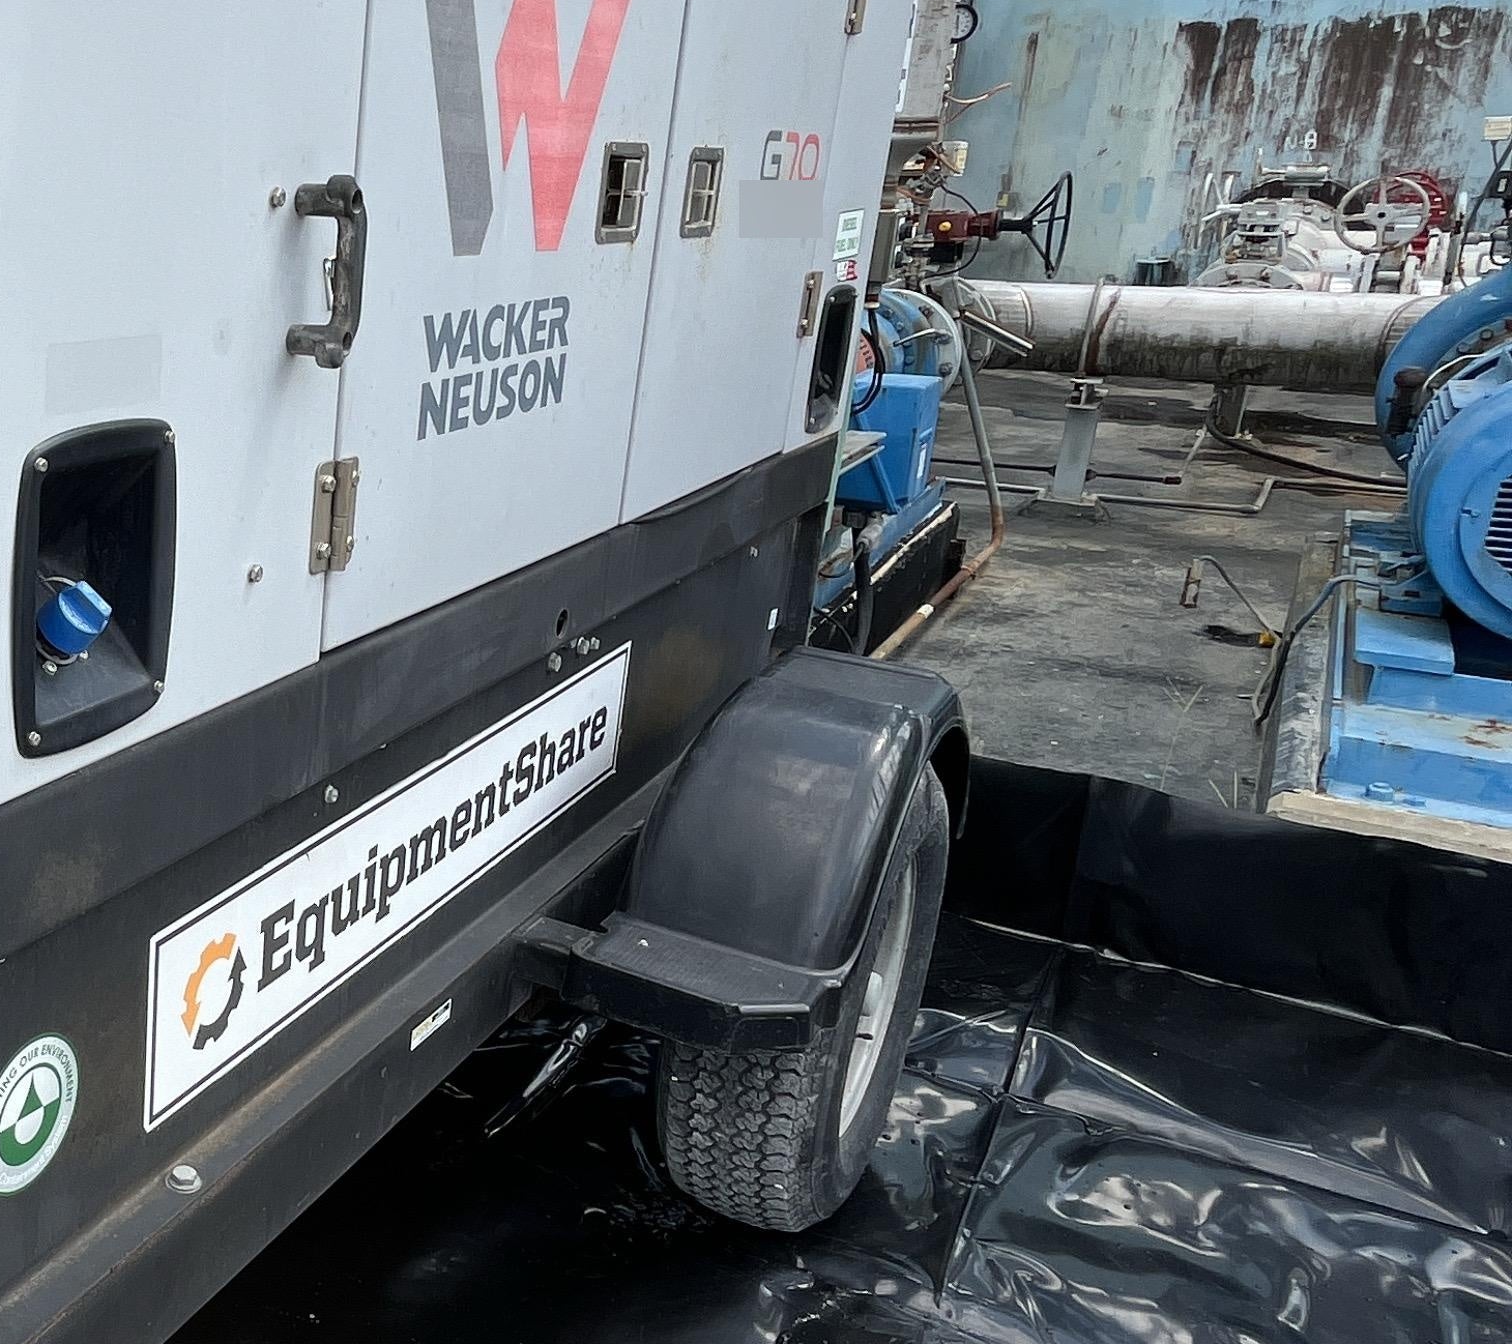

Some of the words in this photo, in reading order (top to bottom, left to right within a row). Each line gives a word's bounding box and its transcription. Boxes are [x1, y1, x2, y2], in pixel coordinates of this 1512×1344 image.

[759, 129, 820, 181] G70
[423, 295, 570, 373] WACKER
[416, 352, 568, 441] NEUSON
[257, 705, 608, 993] EquipmentShare
[19, 1046, 40, 1068] OUR
[40, 1044, 75, 1104] ENVIRONMENT
